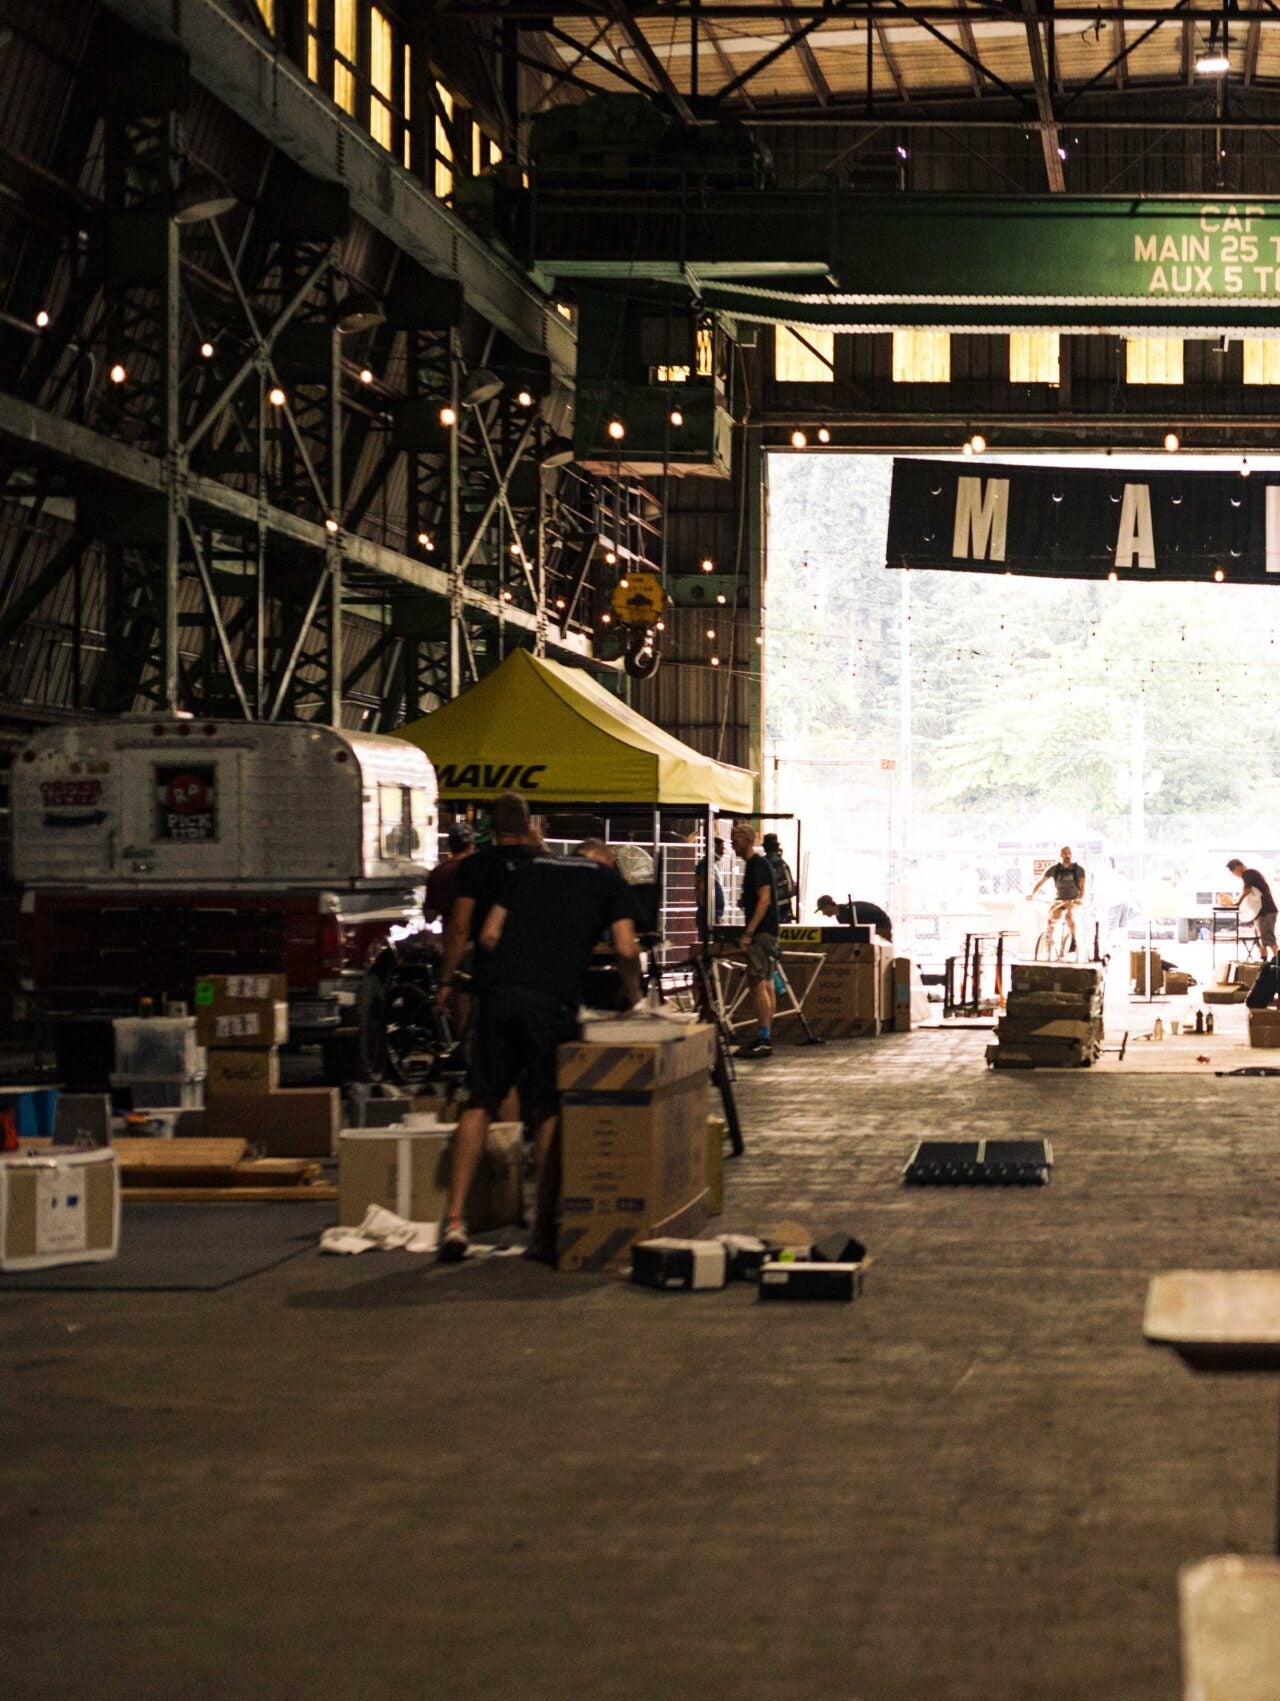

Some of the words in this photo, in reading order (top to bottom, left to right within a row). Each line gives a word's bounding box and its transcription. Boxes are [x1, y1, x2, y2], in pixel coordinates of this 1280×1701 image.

[1200, 206, 1265, 233] CAP
[1134, 235, 1210, 262] MAIN
[1220, 236, 1259, 263] 25
[1149, 265, 1213, 293] AUX
[1224, 267, 1243, 293] 5
[434, 764, 548, 788] MAVIC
[166, 813, 213, 829] PICK
[781, 929, 818, 940] AVIC
